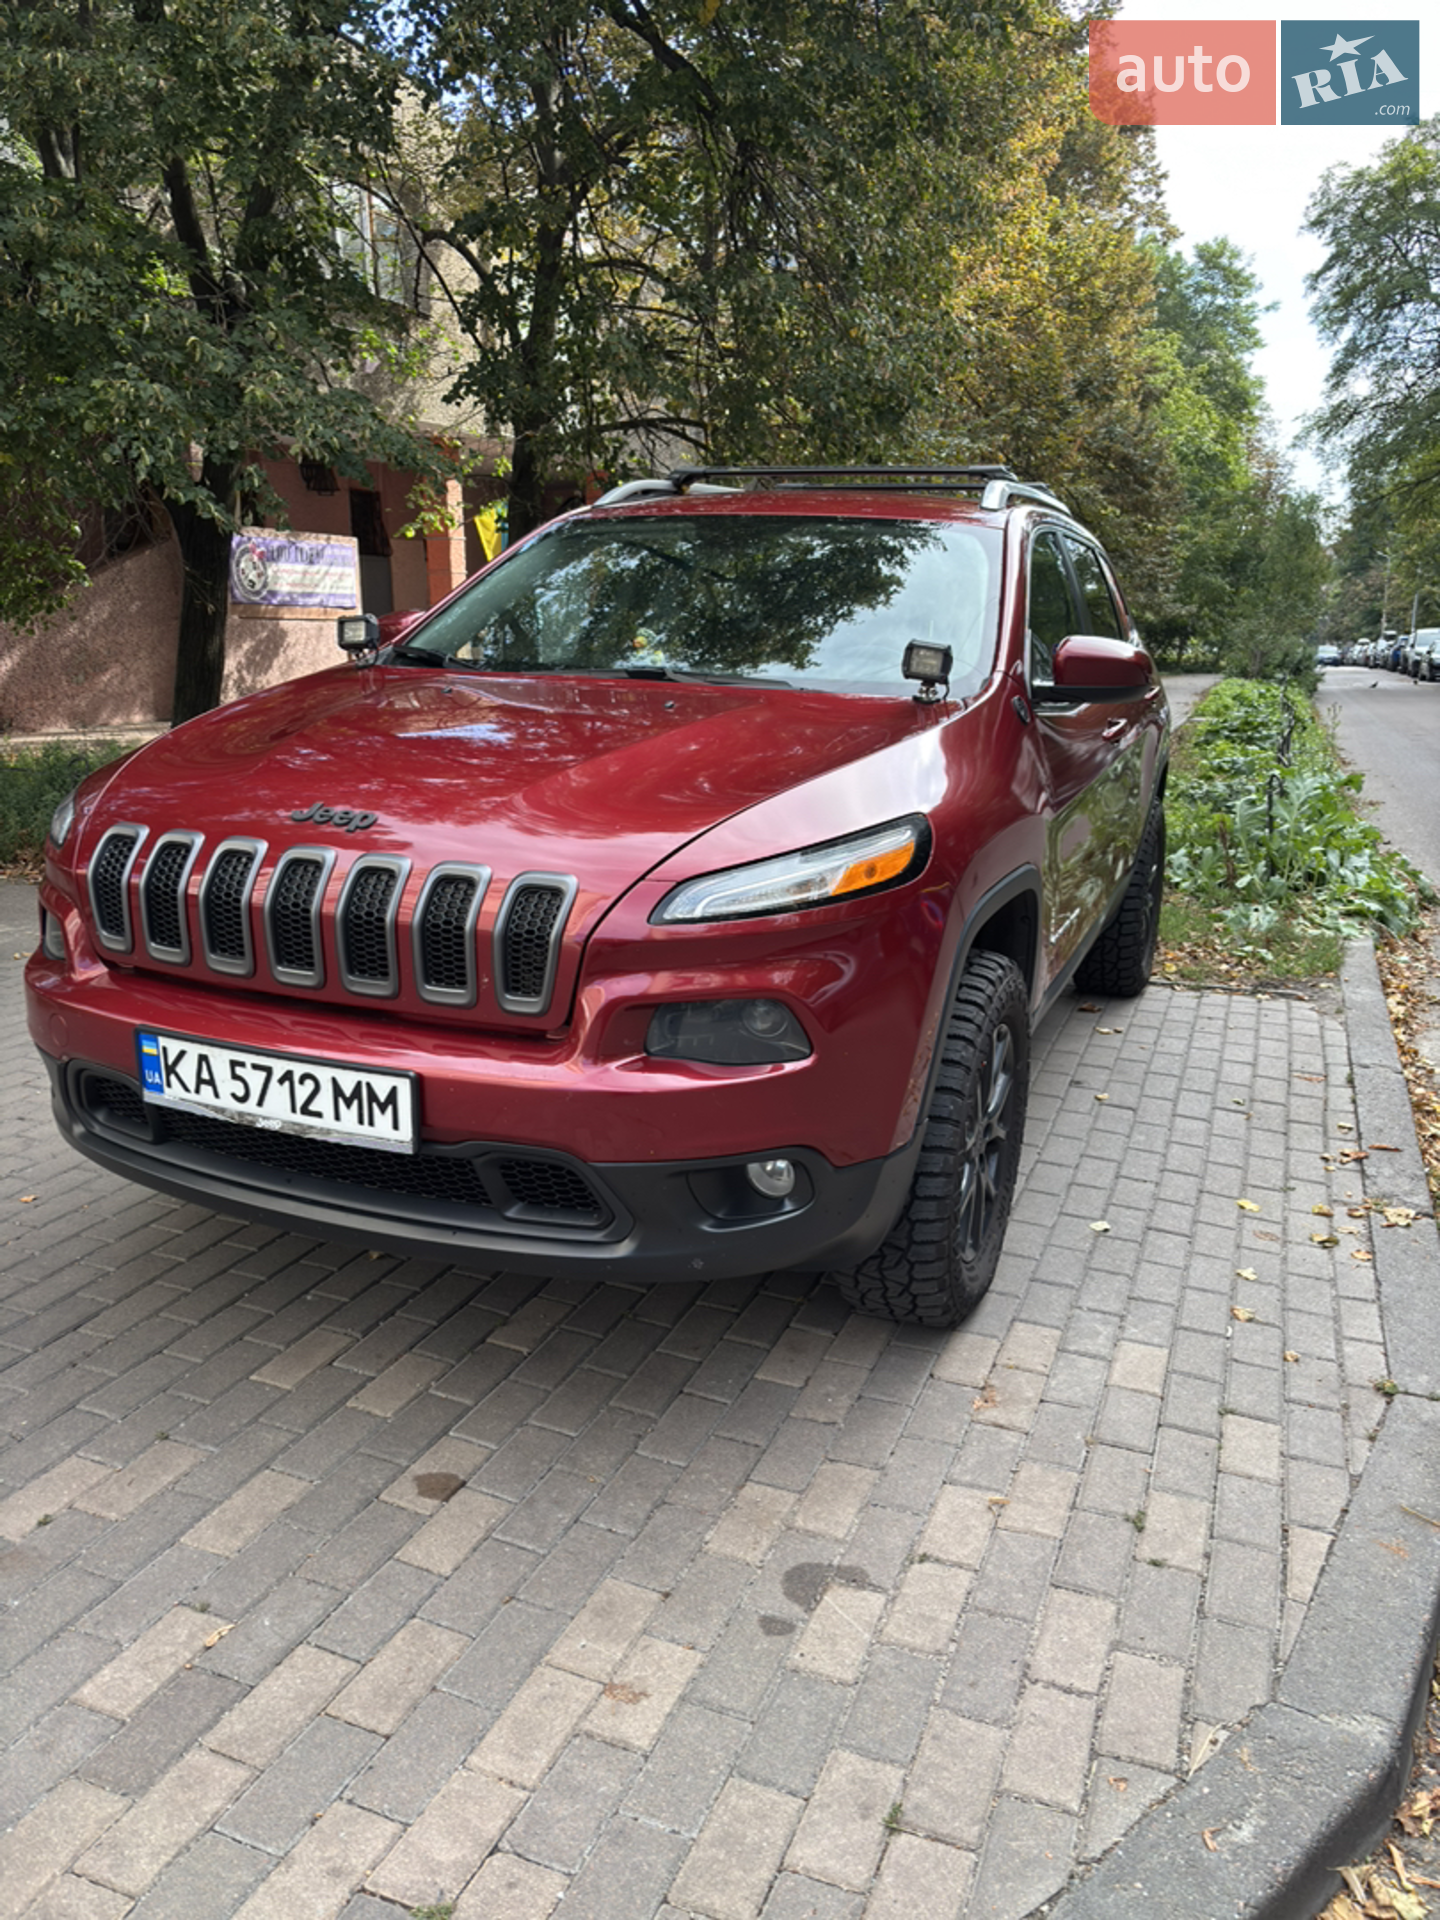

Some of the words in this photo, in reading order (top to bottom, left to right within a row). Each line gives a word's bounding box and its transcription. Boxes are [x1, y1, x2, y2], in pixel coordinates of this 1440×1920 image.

[291, 802, 378, 833] Jeep
[145, 1069, 162, 1085] UA
[162, 1045, 220, 1100] KA
[228, 1058, 324, 1119] 5712
[331, 1075, 400, 1132] MM
[256, 1117, 282, 1131] Jeep
